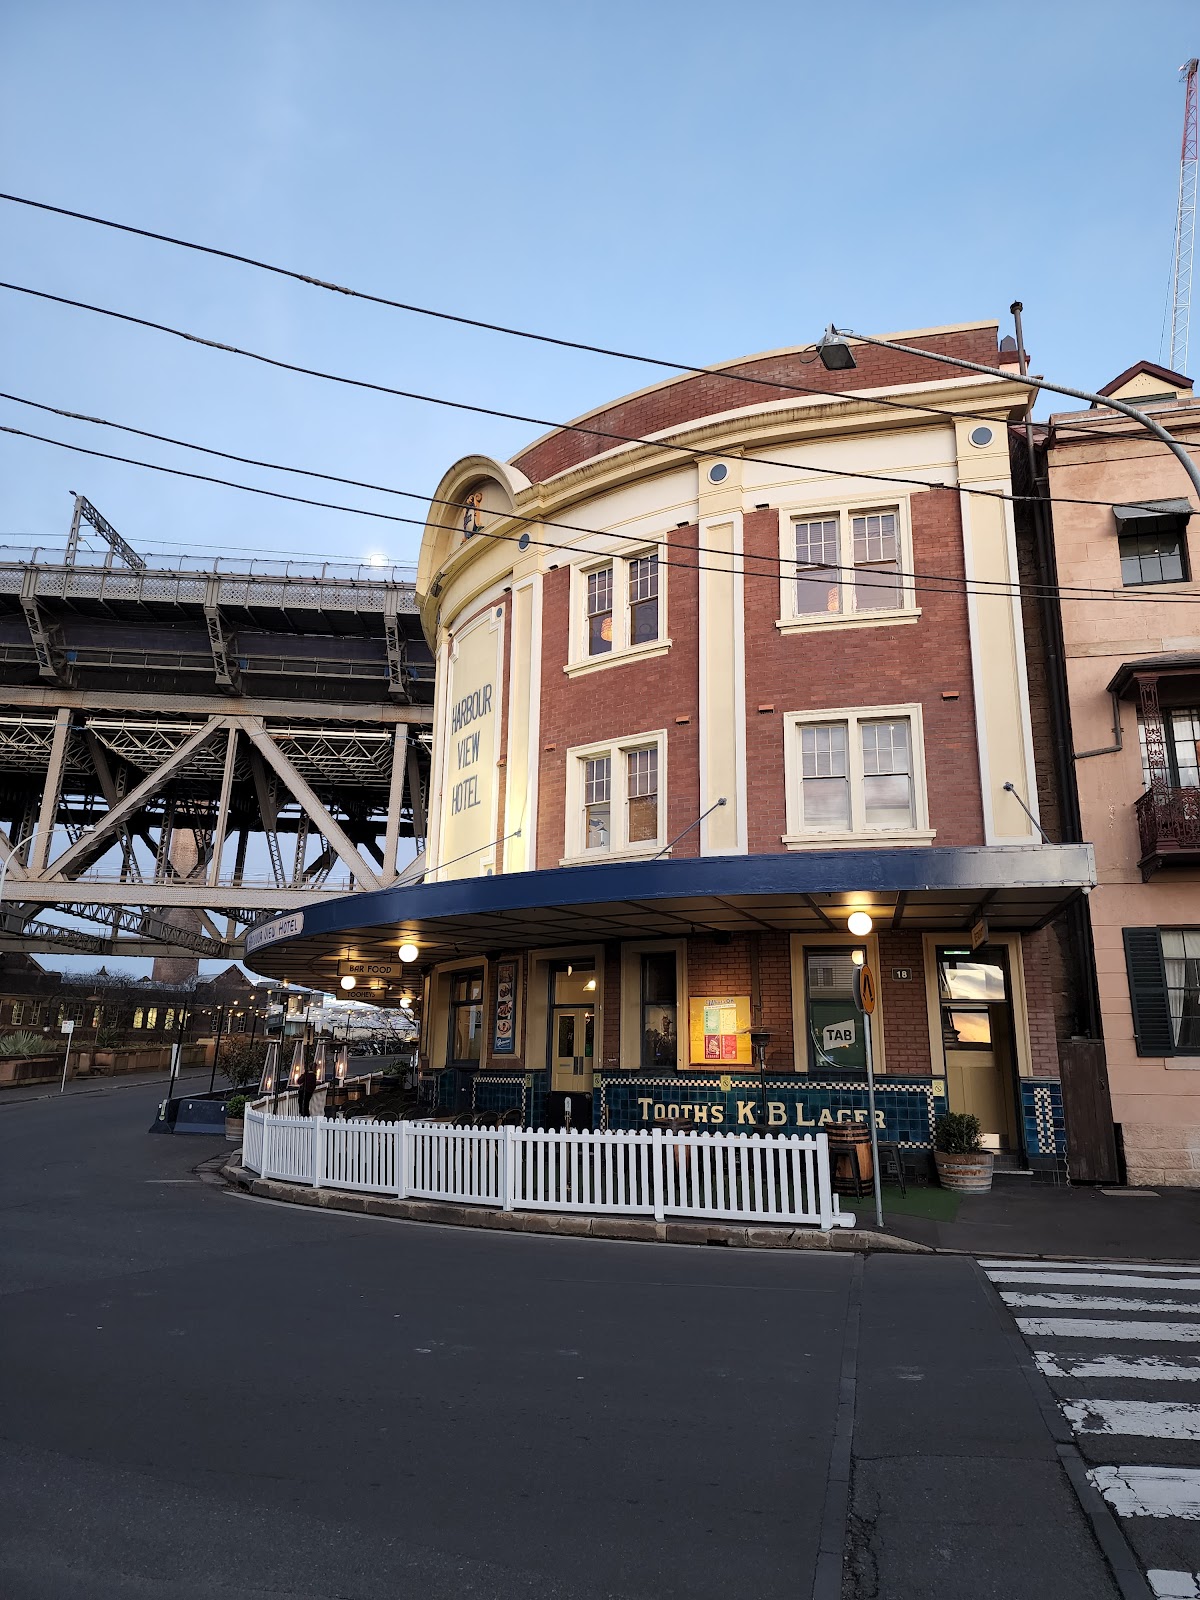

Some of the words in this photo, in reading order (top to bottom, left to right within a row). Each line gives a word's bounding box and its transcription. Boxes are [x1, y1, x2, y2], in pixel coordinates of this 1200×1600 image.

[451, 683, 492, 736] HARBOUR
[457, 730, 480, 770] VIEW
[451, 774, 481, 816] HOTEL
[278, 918, 298, 936] HOTEL
[349, 964, 365, 973] BAR
[367, 965, 392, 974] FOOD
[896, 970, 908, 979] 18
[346, 990, 376, 999] TOOHEYS
[826, 1029, 852, 1041] TAB
